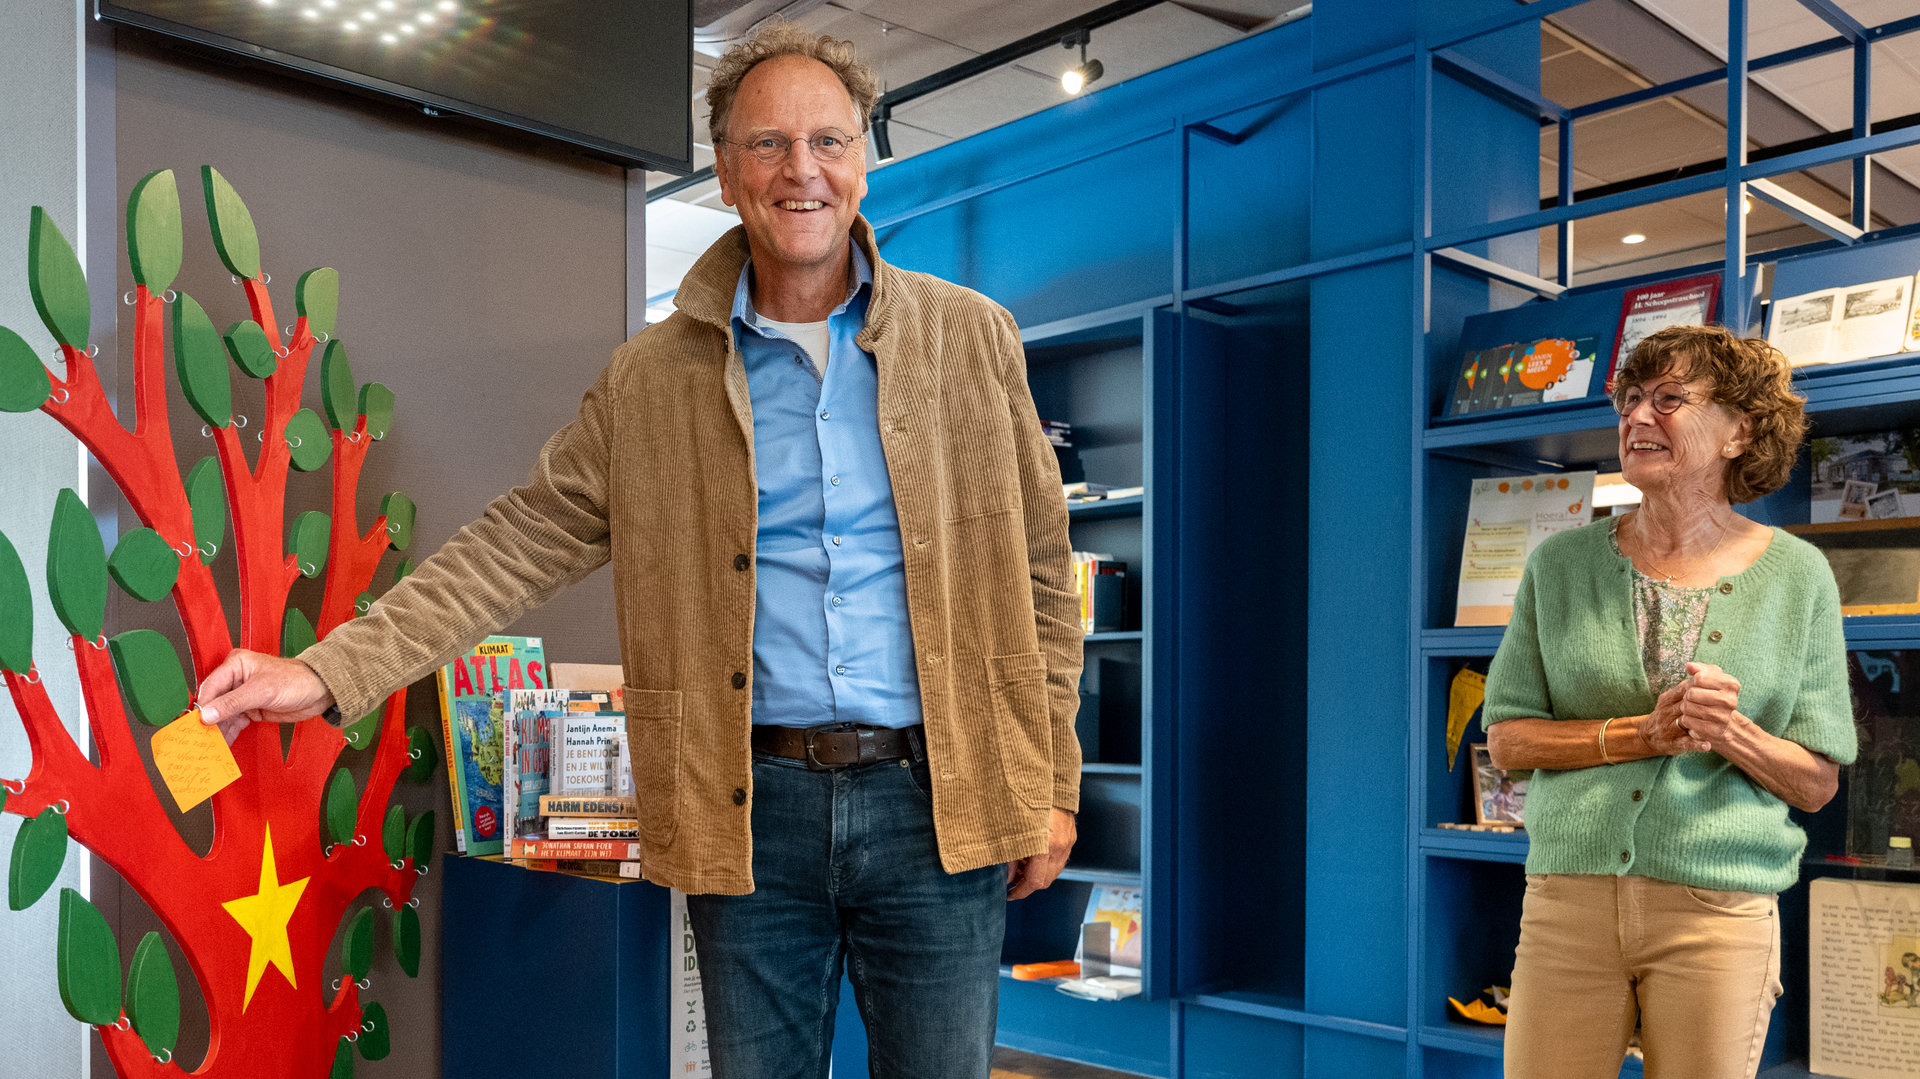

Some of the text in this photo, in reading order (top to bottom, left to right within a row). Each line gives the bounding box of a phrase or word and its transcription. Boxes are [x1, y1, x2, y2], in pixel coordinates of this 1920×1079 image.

[1636, 291, 1666, 301] 100 jaar
[479, 645, 508, 654] KLIMAAT
[454, 656, 544, 697] ATLAS
[566, 723, 617, 734] Jantijn Anema
[566, 737, 595, 746] Hannah
[566, 750, 574, 758] JE
[577, 749, 597, 758] BENT
[566, 762, 577, 771] EN
[579, 762, 588, 771] JE
[590, 762, 604, 770] WIL
[566, 775, 608, 784] TOEKOMST
[548, 801, 580, 812] HARM
[583, 801, 619, 813] EDENS
